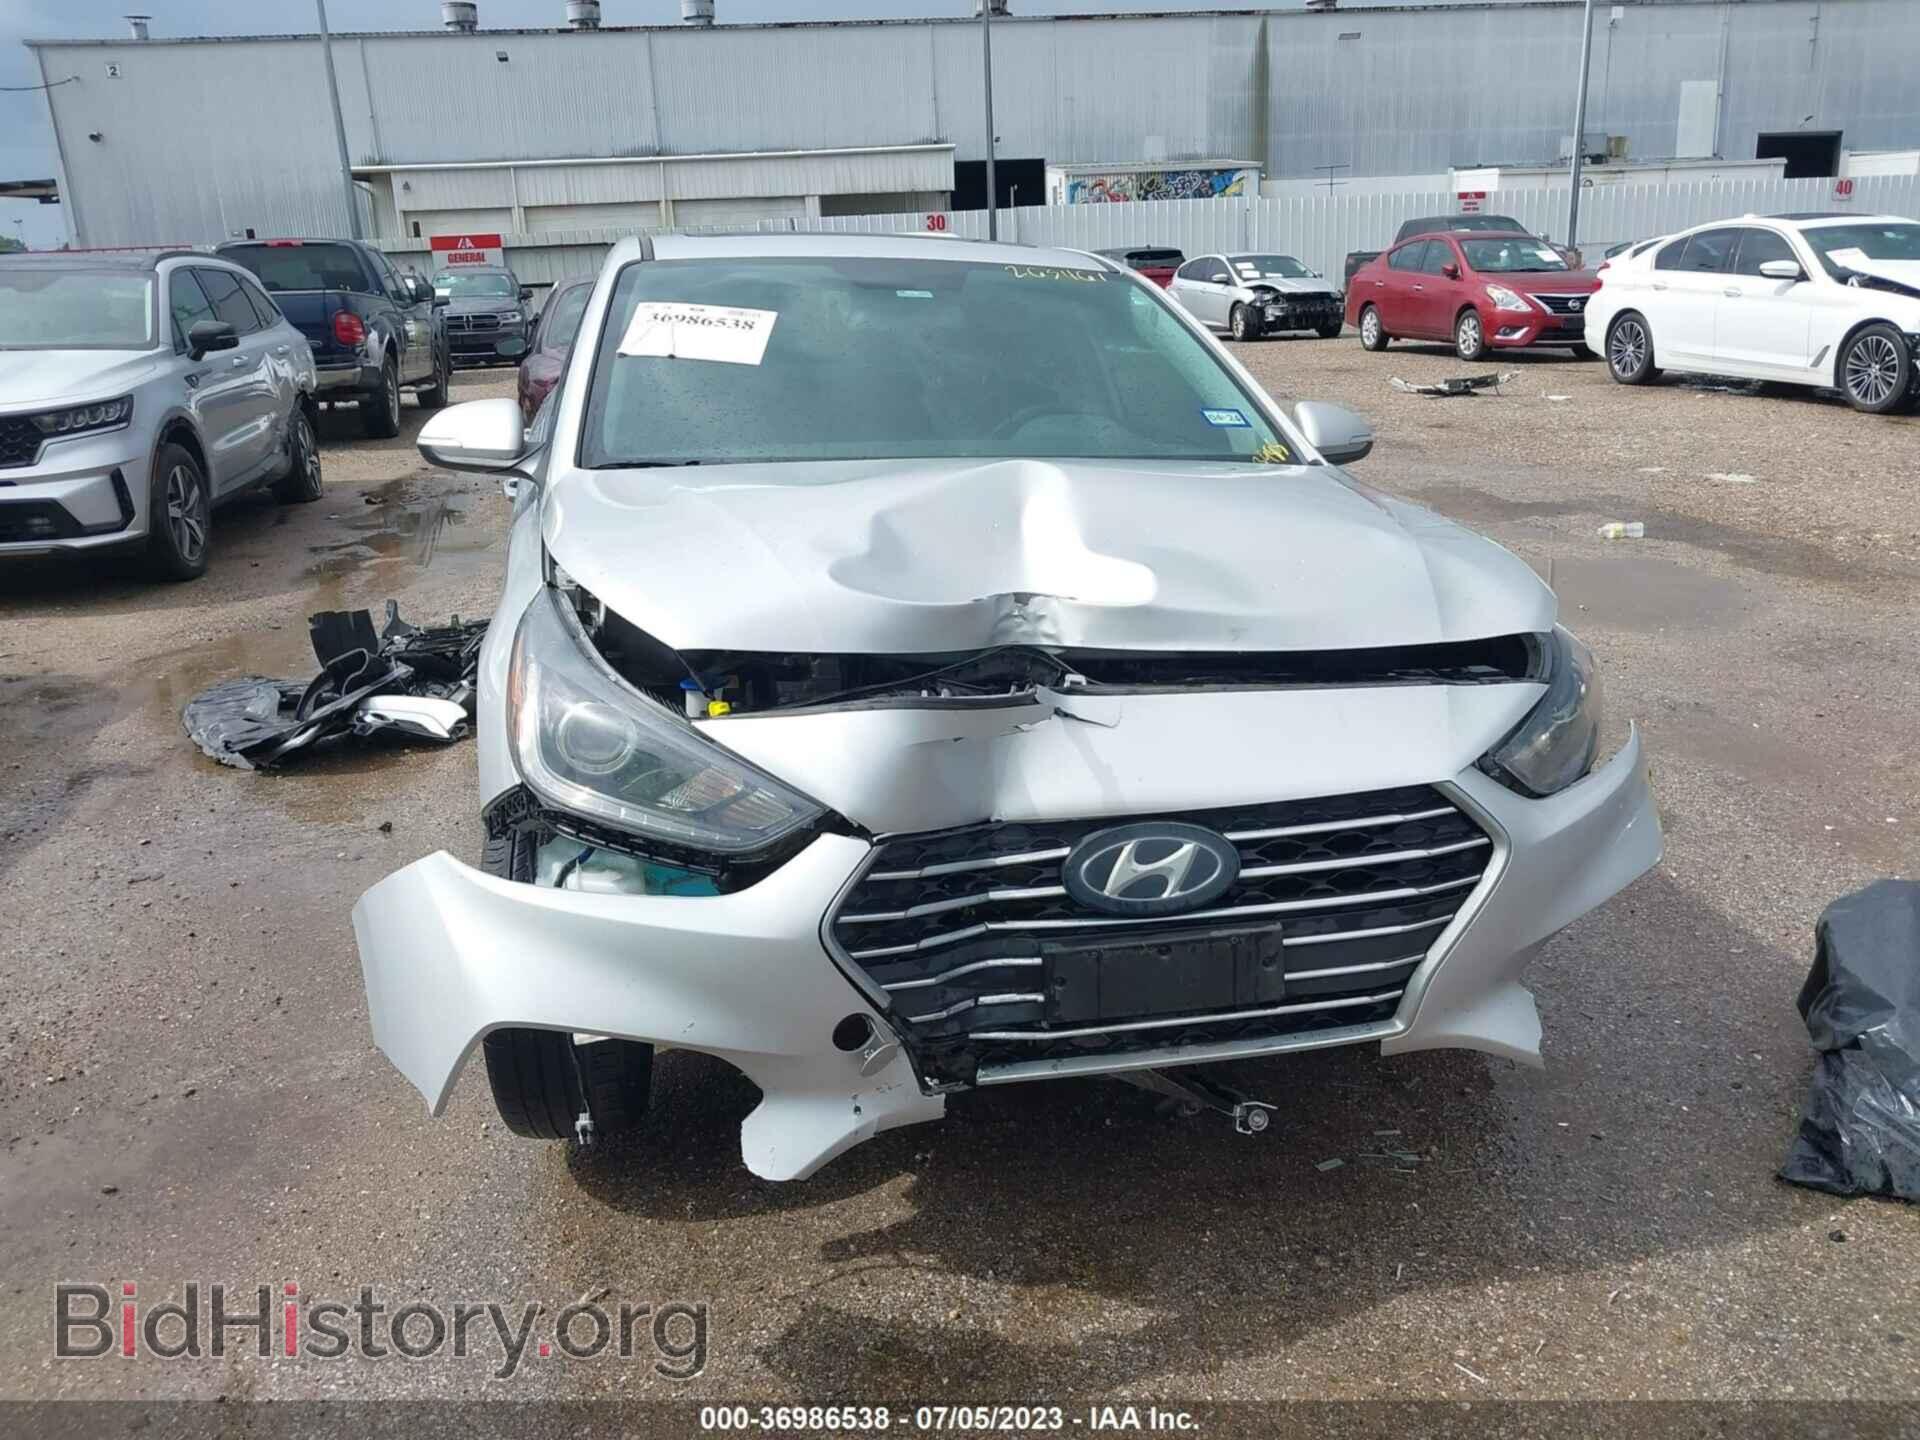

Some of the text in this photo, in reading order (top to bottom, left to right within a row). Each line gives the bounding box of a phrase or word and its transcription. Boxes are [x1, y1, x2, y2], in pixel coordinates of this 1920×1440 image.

[109, 66, 118, 76] 2
[1836, 180, 1853, 194] 40
[927, 215, 945, 231] 30
[447, 252, 485, 264] GENERAL
[651, 312, 757, 331] 36986538
